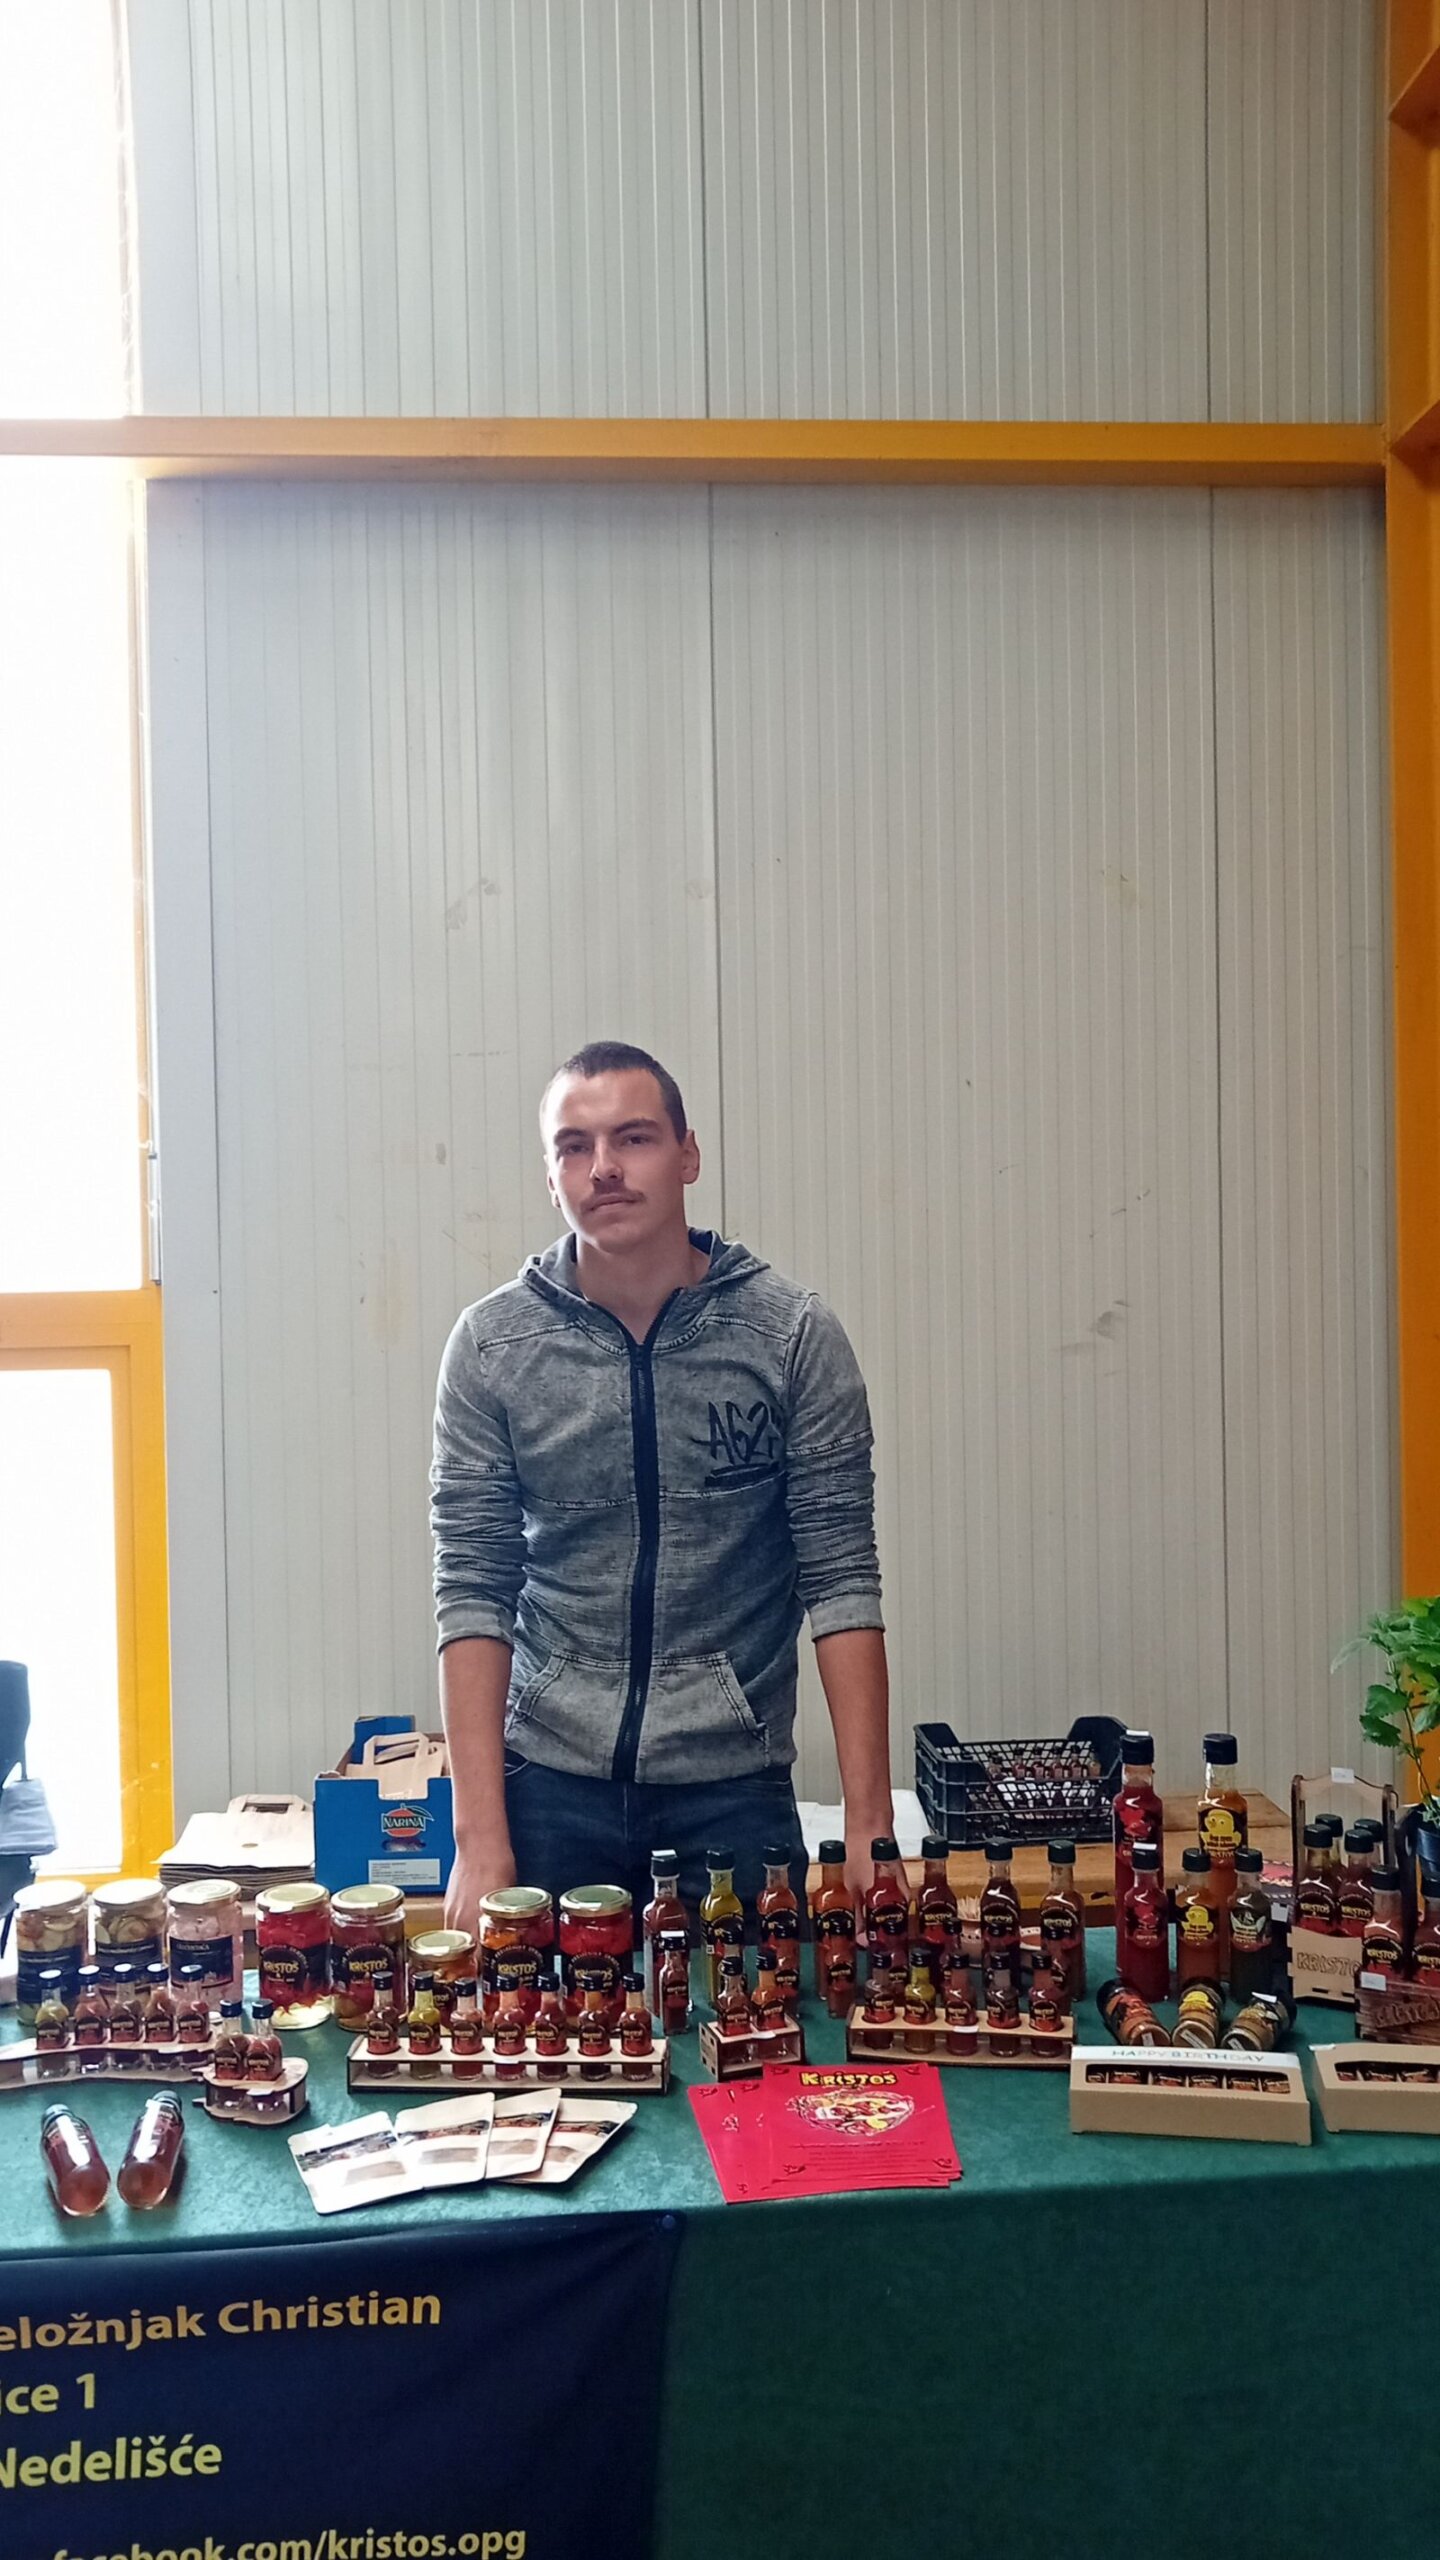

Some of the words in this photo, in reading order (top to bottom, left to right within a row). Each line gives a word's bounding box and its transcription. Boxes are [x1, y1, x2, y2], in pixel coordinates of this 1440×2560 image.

[383, 1816, 425, 1828] NARINA
[0, 2305, 206, 2351] eložnjak
[218, 2290, 441, 2334] Christian
[0, 2380, 60, 2416] ce
[75, 2372, 95, 2409] 1
